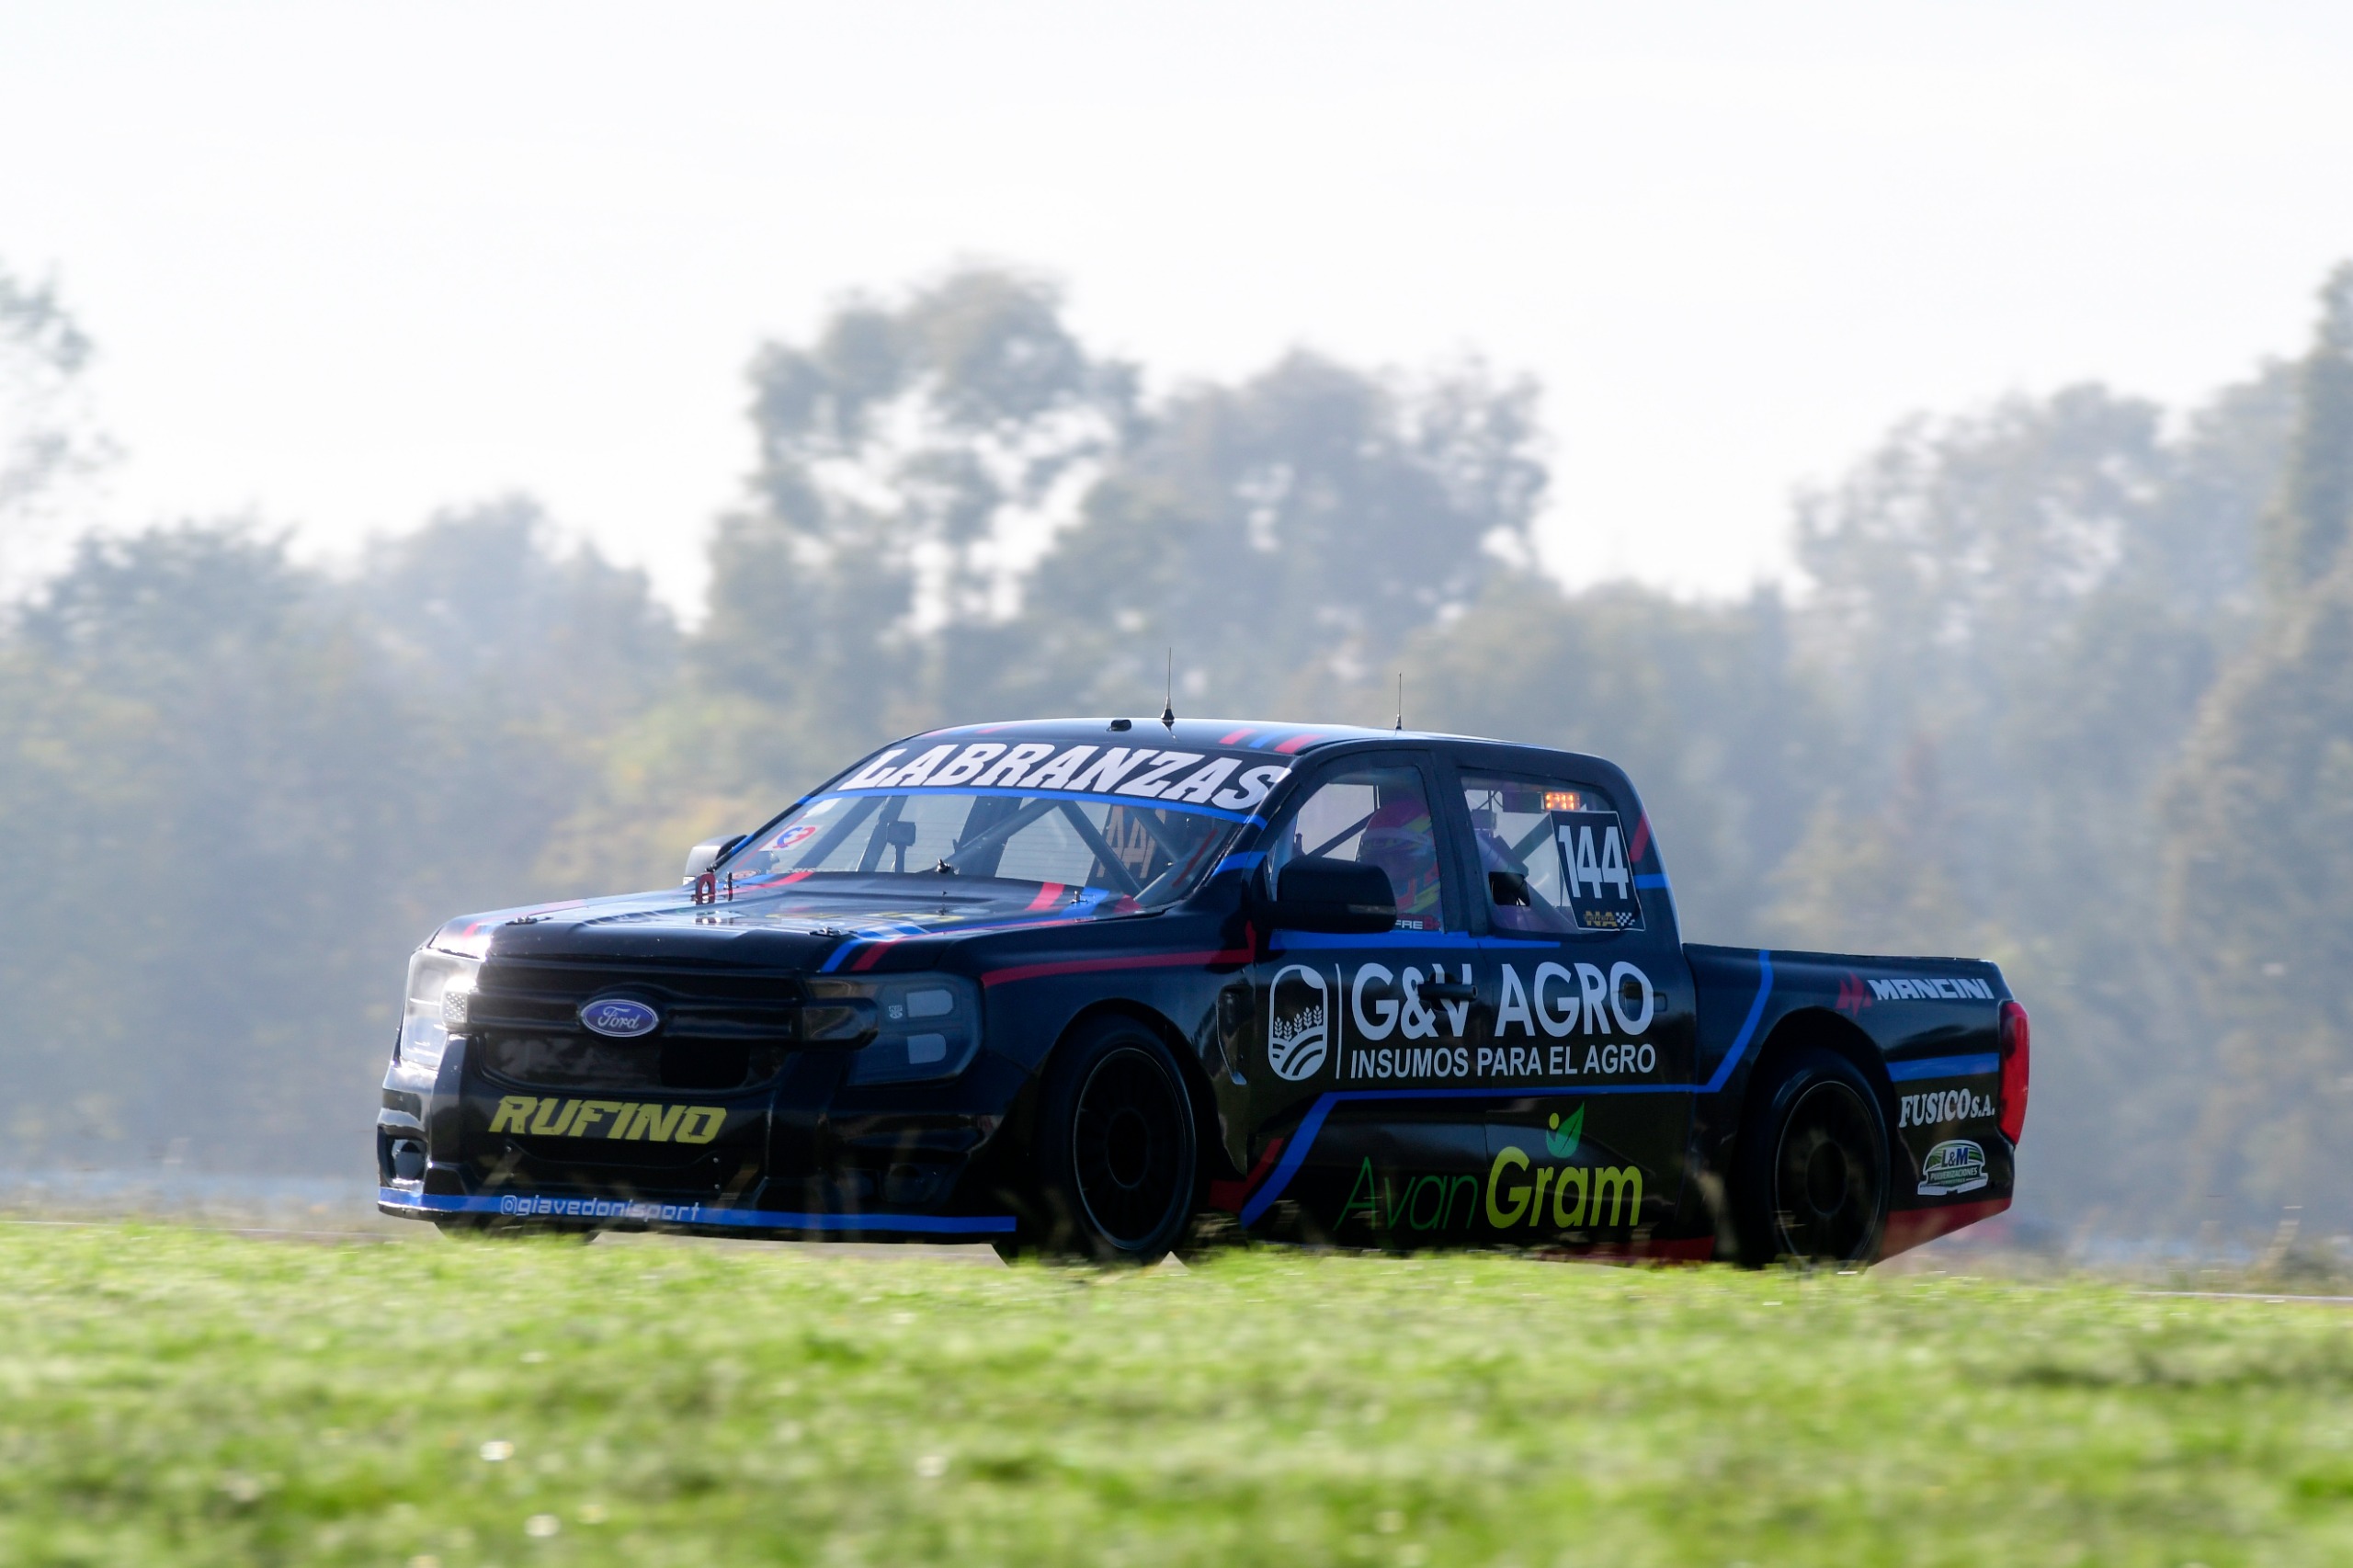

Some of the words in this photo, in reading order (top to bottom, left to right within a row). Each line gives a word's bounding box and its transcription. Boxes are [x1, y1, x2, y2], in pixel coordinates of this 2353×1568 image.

[838, 742, 1291, 810] LABRANZAS
[1558, 824, 1629, 900] 144
[1352, 962, 1472, 1040] G&V
[1495, 961, 1654, 1037] AGRO
[1868, 978, 1995, 1000] MANCINI
[597, 1006, 641, 1028] Ford
[1350, 1048, 1469, 1079] INSUMOS
[1477, 1047, 1543, 1077] PARA
[1549, 1046, 1578, 1075] EL
[1583, 1043, 1656, 1074] AGRO
[488, 1095, 727, 1144] RUFINO
[1898, 1087, 1972, 1128] FUSICO
[1941, 1147, 1969, 1167] L&M
